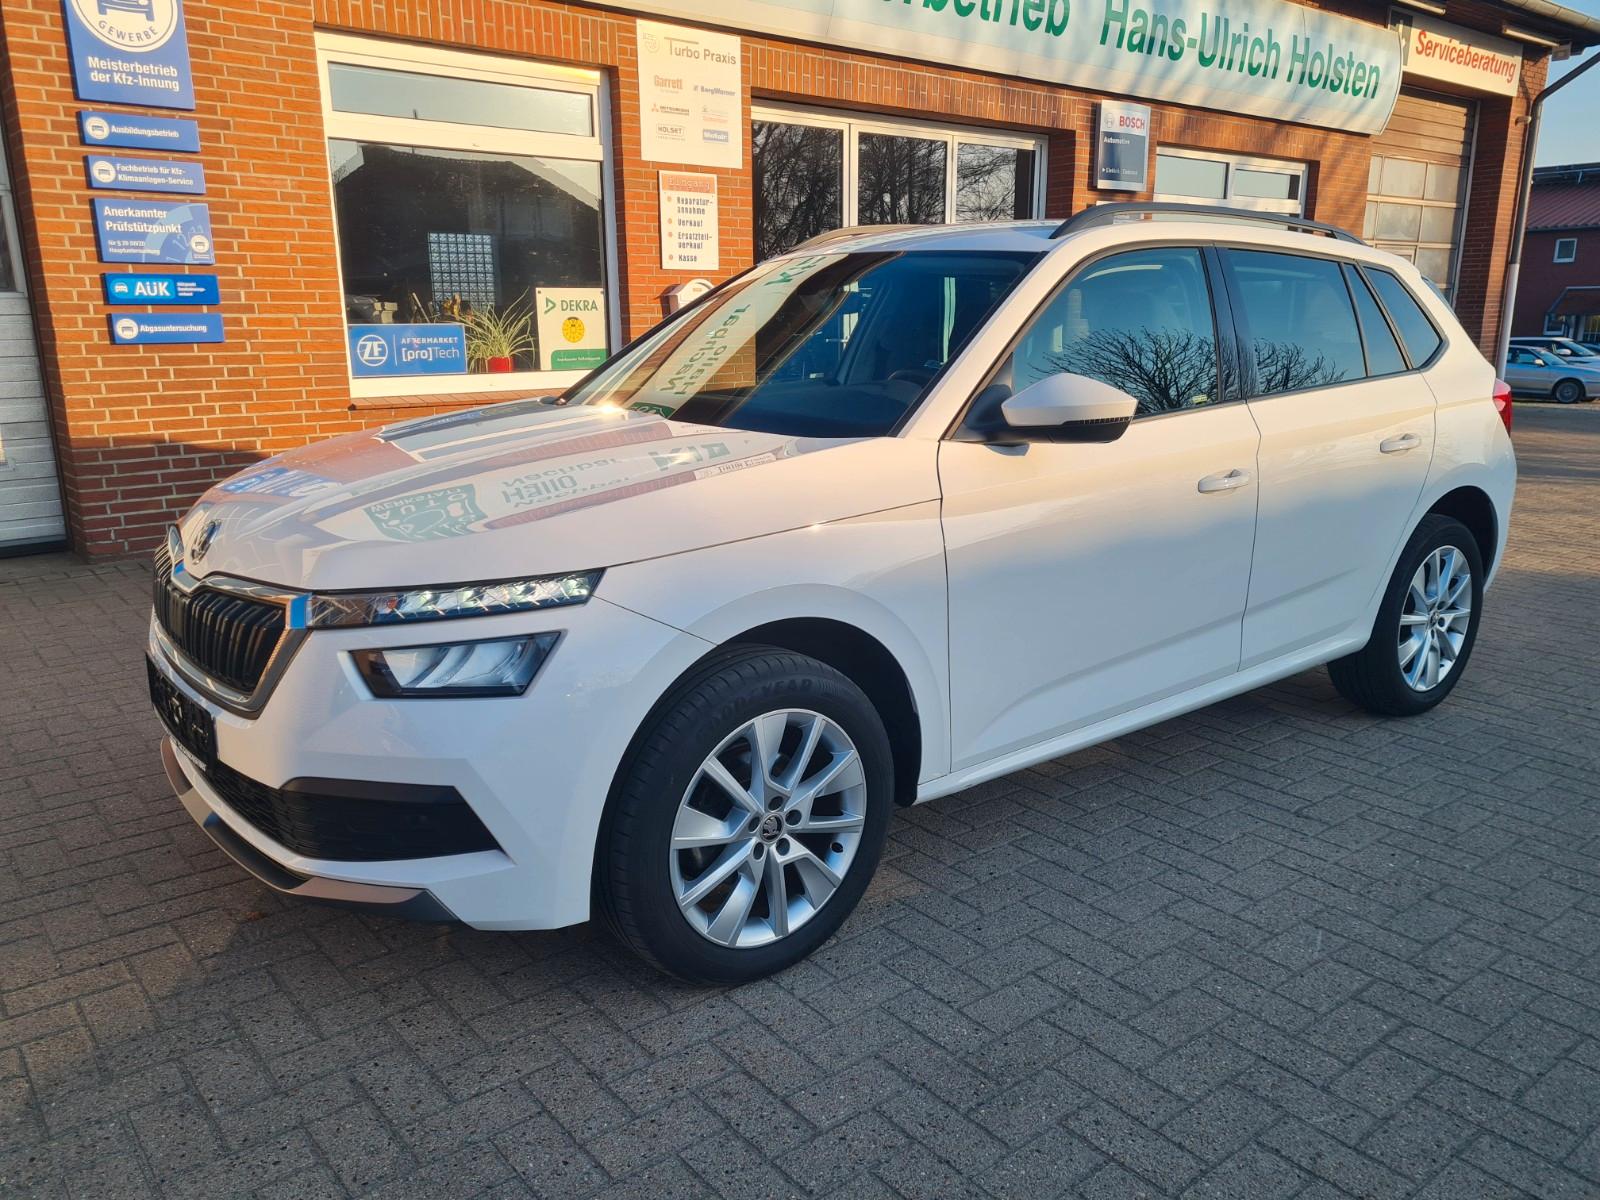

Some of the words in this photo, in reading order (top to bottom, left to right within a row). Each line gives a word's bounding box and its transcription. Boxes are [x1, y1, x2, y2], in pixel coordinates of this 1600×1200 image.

[98, 20, 158, 42] GEWERBE
[664, 36, 700, 60] Turbo
[703, 48, 737, 65] Praxis
[1099, 0, 1281, 80] Hans-Ulrich
[1286, 35, 1382, 99] Holsten
[1416, 29, 1517, 83] Serviceberatung
[88, 56, 178, 77] Meisterbetrieb
[91, 70, 111, 83] der
[113, 72, 180, 92] Kfz-Innung
[1119, 115, 1145, 130] BOSCH
[111, 125, 180, 138] Ausbildungsbetrieb
[116, 163, 159, 175] Fachbetrieb
[104, 206, 167, 219] Anerkannter
[105, 220, 182, 235] Prüfstützpunkt
[678, 254, 698, 262] Kasse
[560, 299, 599, 312] DEKRA
[140, 324, 208, 334] Abgasuntersuchung
[360, 341, 385, 360] ZF
[401, 337, 458, 345] AFTERMARKET
[402, 347, 460, 363] [pro]Tech
